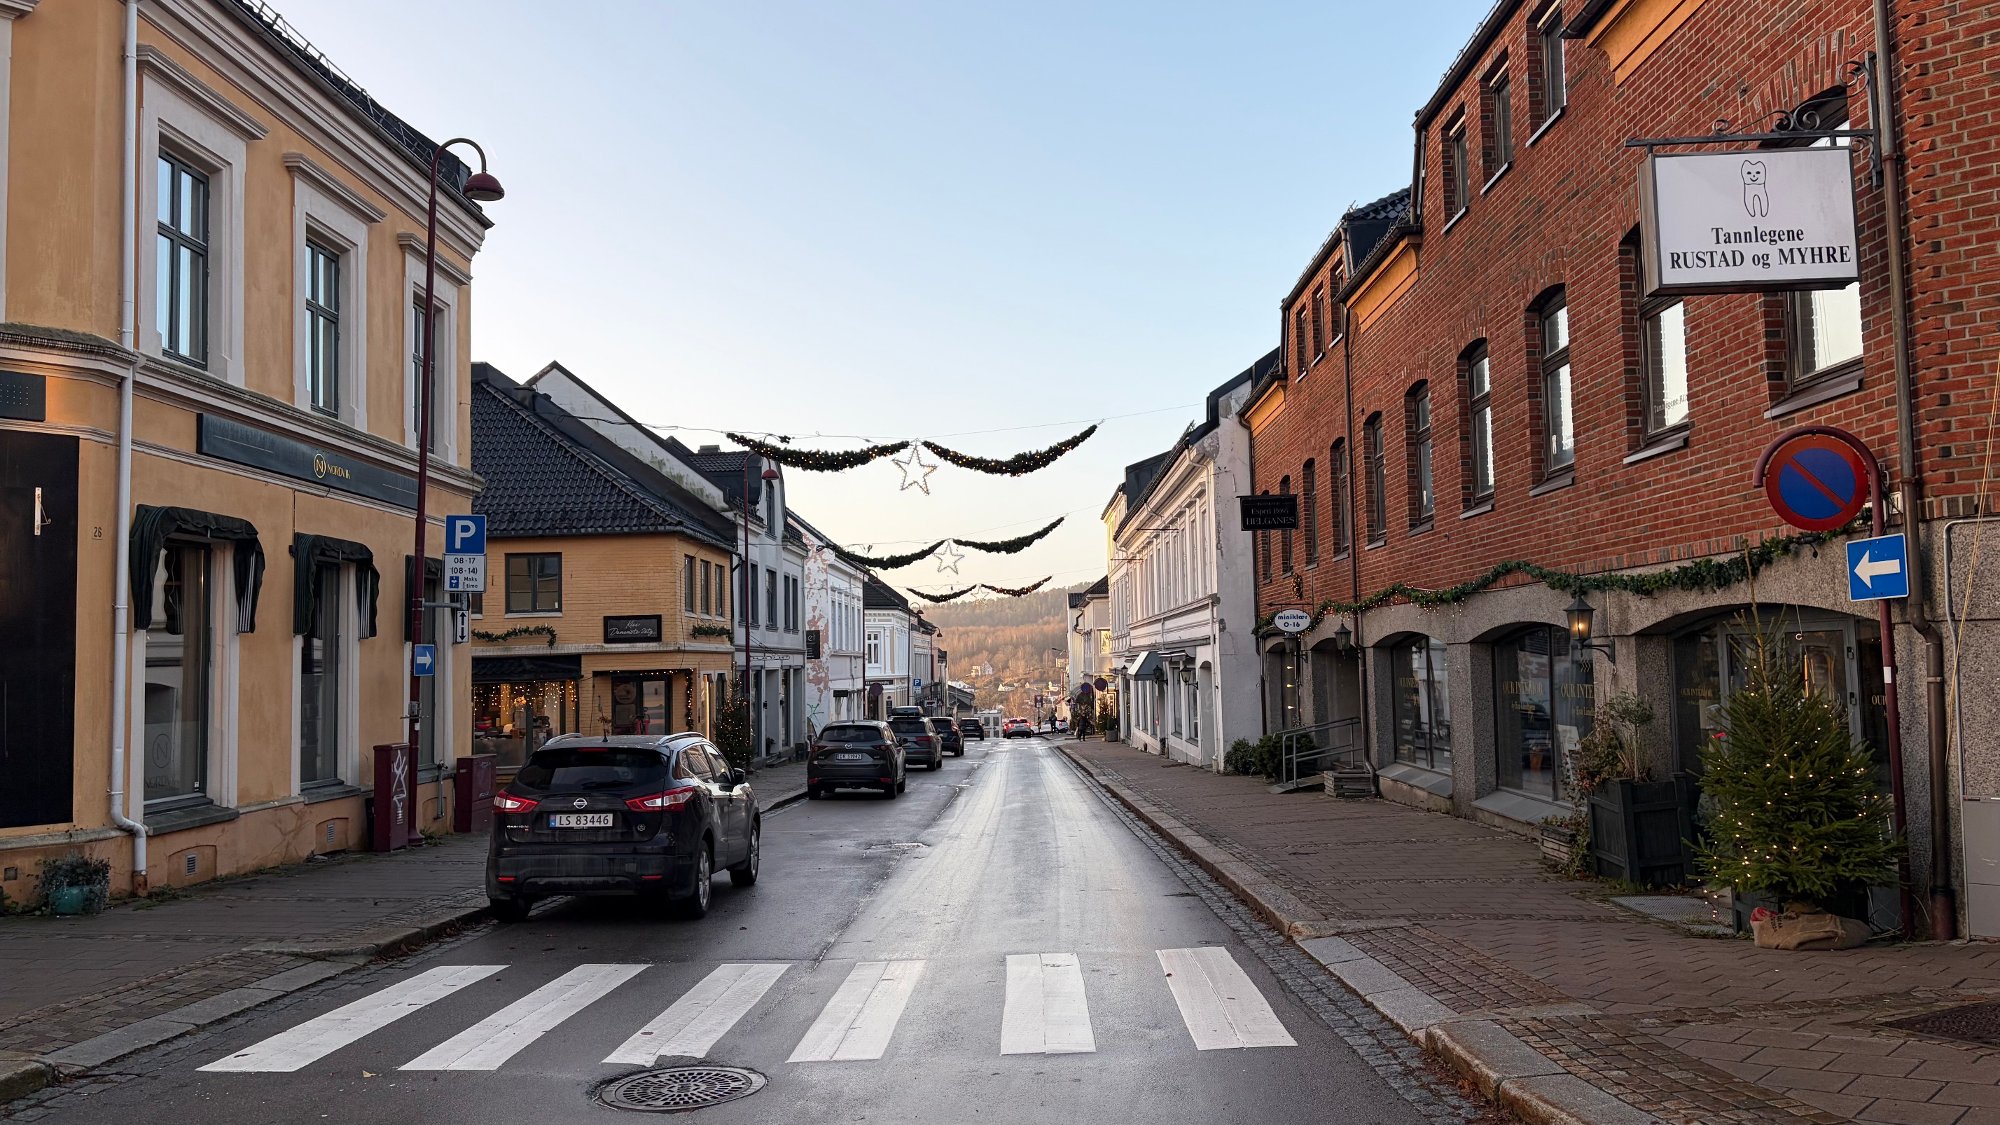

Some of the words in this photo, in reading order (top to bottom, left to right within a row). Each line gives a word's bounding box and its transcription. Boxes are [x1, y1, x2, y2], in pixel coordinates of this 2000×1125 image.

[1711, 226, 1805, 246] Tannlegene
[1670, 250, 1745, 269] RUSTAD
[1751, 253, 1771, 269] og
[1778, 245, 1851, 265] MYHRE
[93, 526, 103, 538] 26
[455, 519, 476, 549] P
[1561, 684, 1576, 697] OUR
[559, 815, 571, 826] LS
[575, 815, 609, 826] 83446
